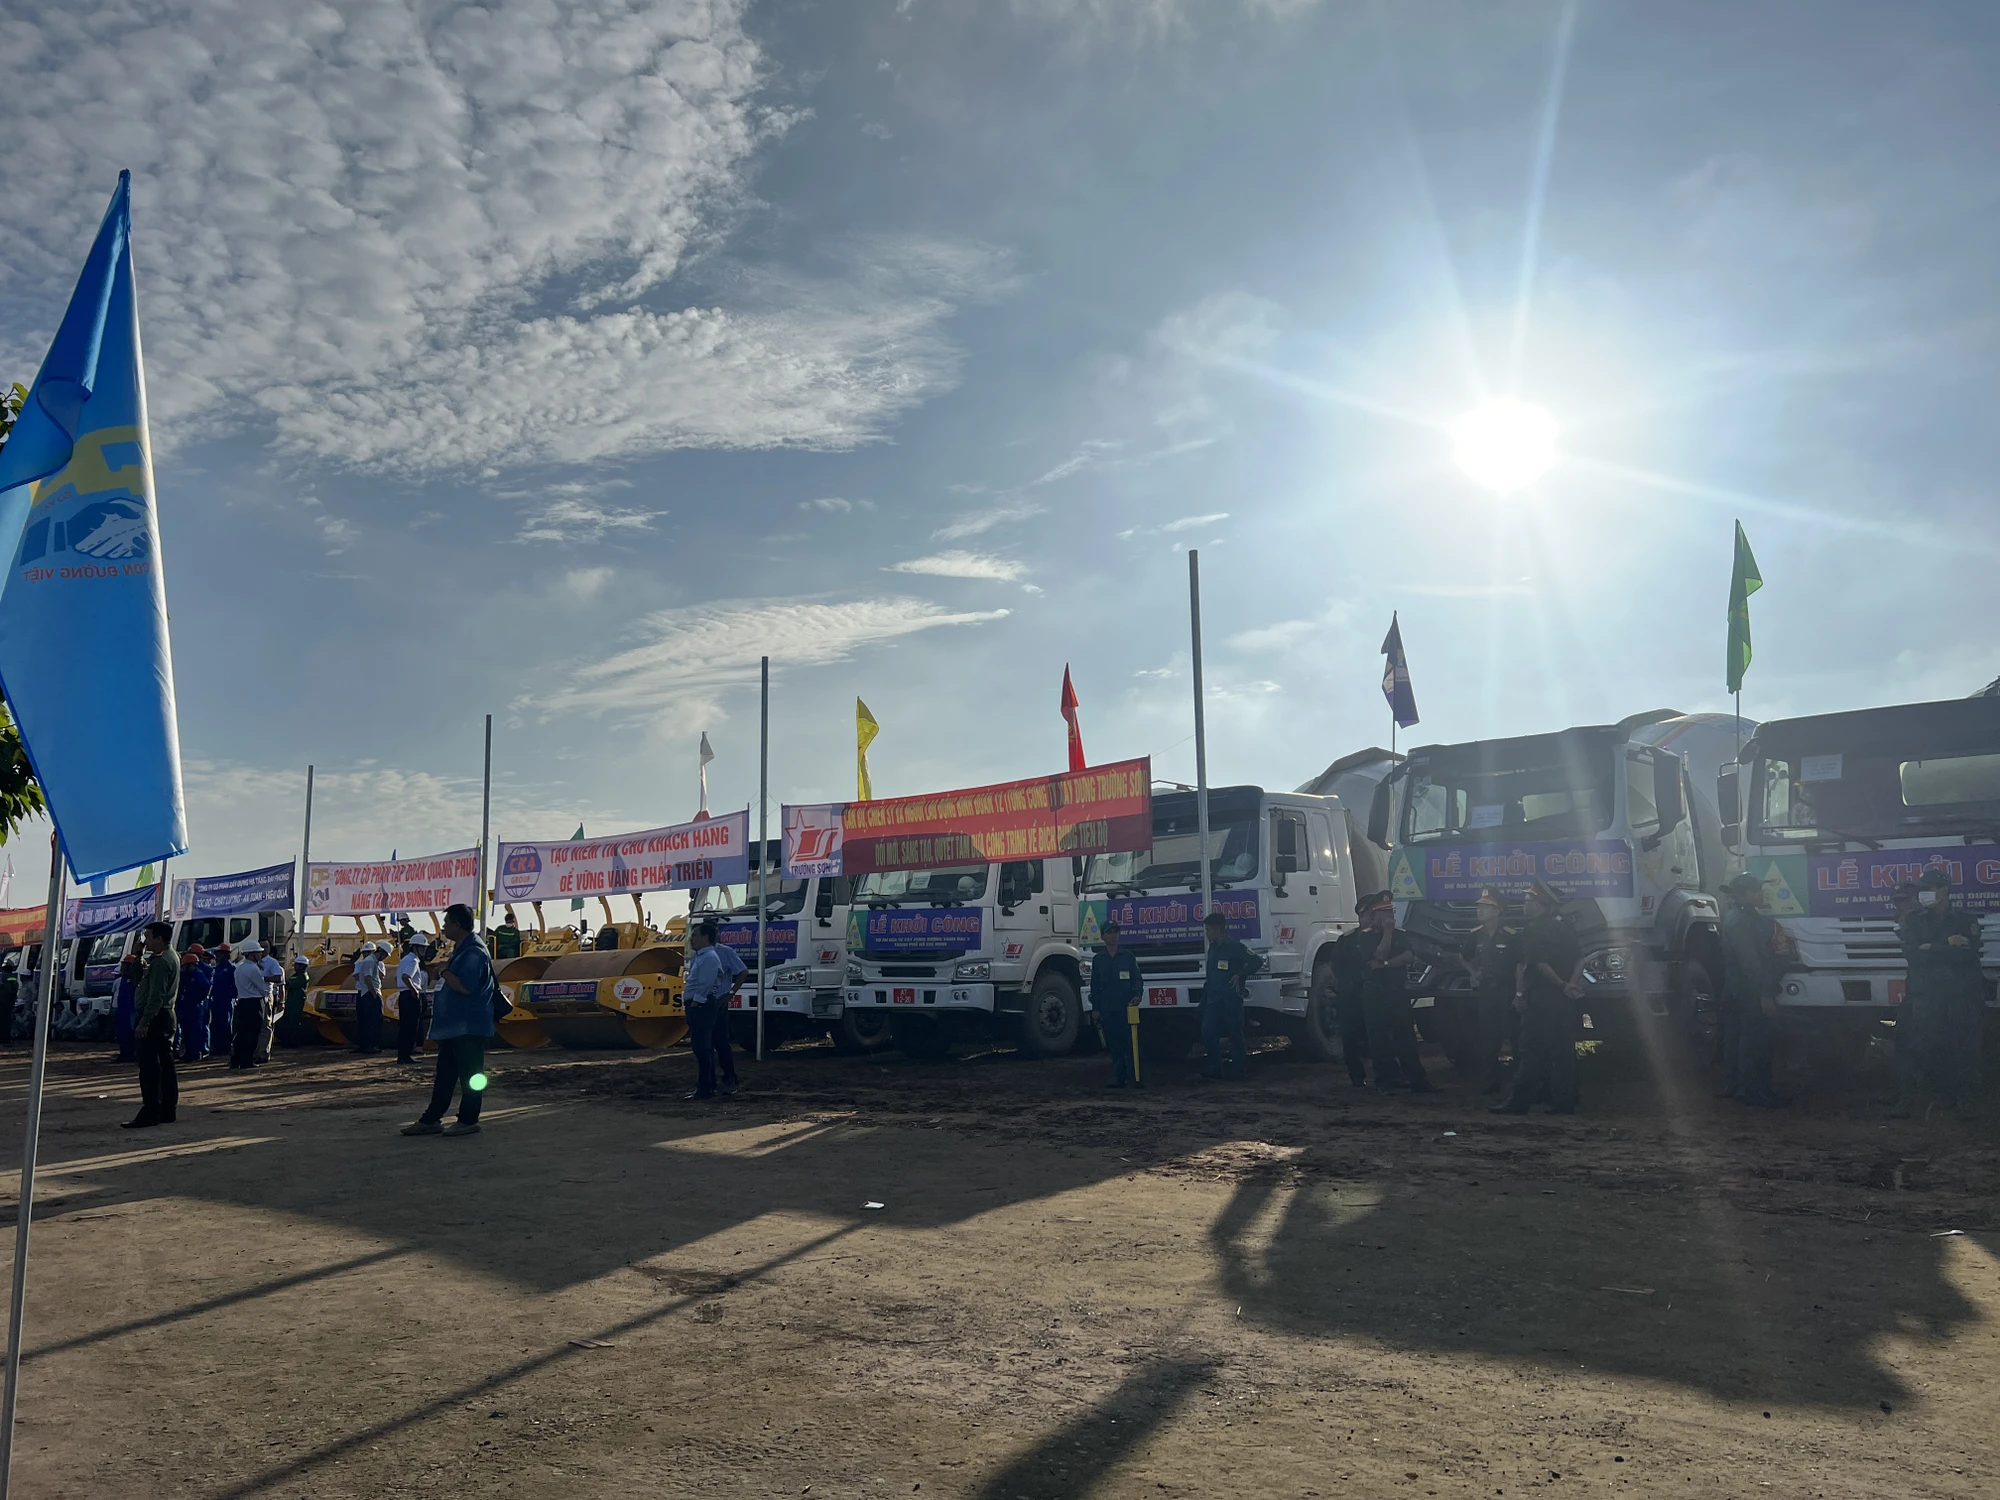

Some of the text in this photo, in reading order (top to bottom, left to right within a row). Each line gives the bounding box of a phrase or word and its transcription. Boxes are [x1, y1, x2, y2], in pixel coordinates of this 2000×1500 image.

[925, 799, 937, 821] LAO
[957, 794, 976, 818] BINH
[976, 789, 994, 815] ĐOÀN
[995, 793, 1004, 814] 12
[1027, 782, 1048, 810] CÔNG
[1074, 778, 1096, 812] DỰNG
[1096, 768, 1128, 801] TRƯỜNG
[550, 847, 568, 867] TẠO
[601, 841, 621, 857] TIN
[622, 837, 646, 855] CHO
[647, 831, 690, 853] KHÁCH
[692, 825, 729, 848] HÀNG
[902, 836, 919, 865] SÁNG
[955, 830, 971, 860] TÂM
[985, 827, 1005, 857] CÔNG
[1005, 825, 1027, 855] TRÌNH
[1027, 820, 1038, 853] VỀ
[1038, 821, 1057, 852] ĐÍCH
[1079, 813, 1097, 848] TIẾN
[1097, 815, 1109, 852] ĐỘ
[352, 869, 360, 885] TY
[427, 861, 453, 882] QUANG
[454, 853, 477, 878] PHÚC
[509, 855, 536, 872] CK4
[559, 853, 713, 892] ĐỂ VỮNG VÀNG PHÁT TRIỂN
[791, 861, 831, 876] TRƯỜNG SƠN
[1432, 849, 1631, 878] LỄ KHỞI CÔNG
[1817, 859, 1860, 891] LỄ
[510, 875, 531, 885] GROUP
[389, 891, 406, 908] CON
[405, 887, 433, 908] ĐƯỜNG
[433, 885, 452, 910] VIỆT
[870, 913, 979, 934] LỄ KHỞI CÔNG
[1111, 903, 1134, 926] LỄ
[1139, 900, 1188, 925] KHỞI
[655, 934, 686, 944] SAKAI
[720, 926, 752, 944] KHỞI
[536, 944, 565, 952] SAKAI
[534, 984, 545, 995] LỄ
[1158, 989, 1167, 997] AT
